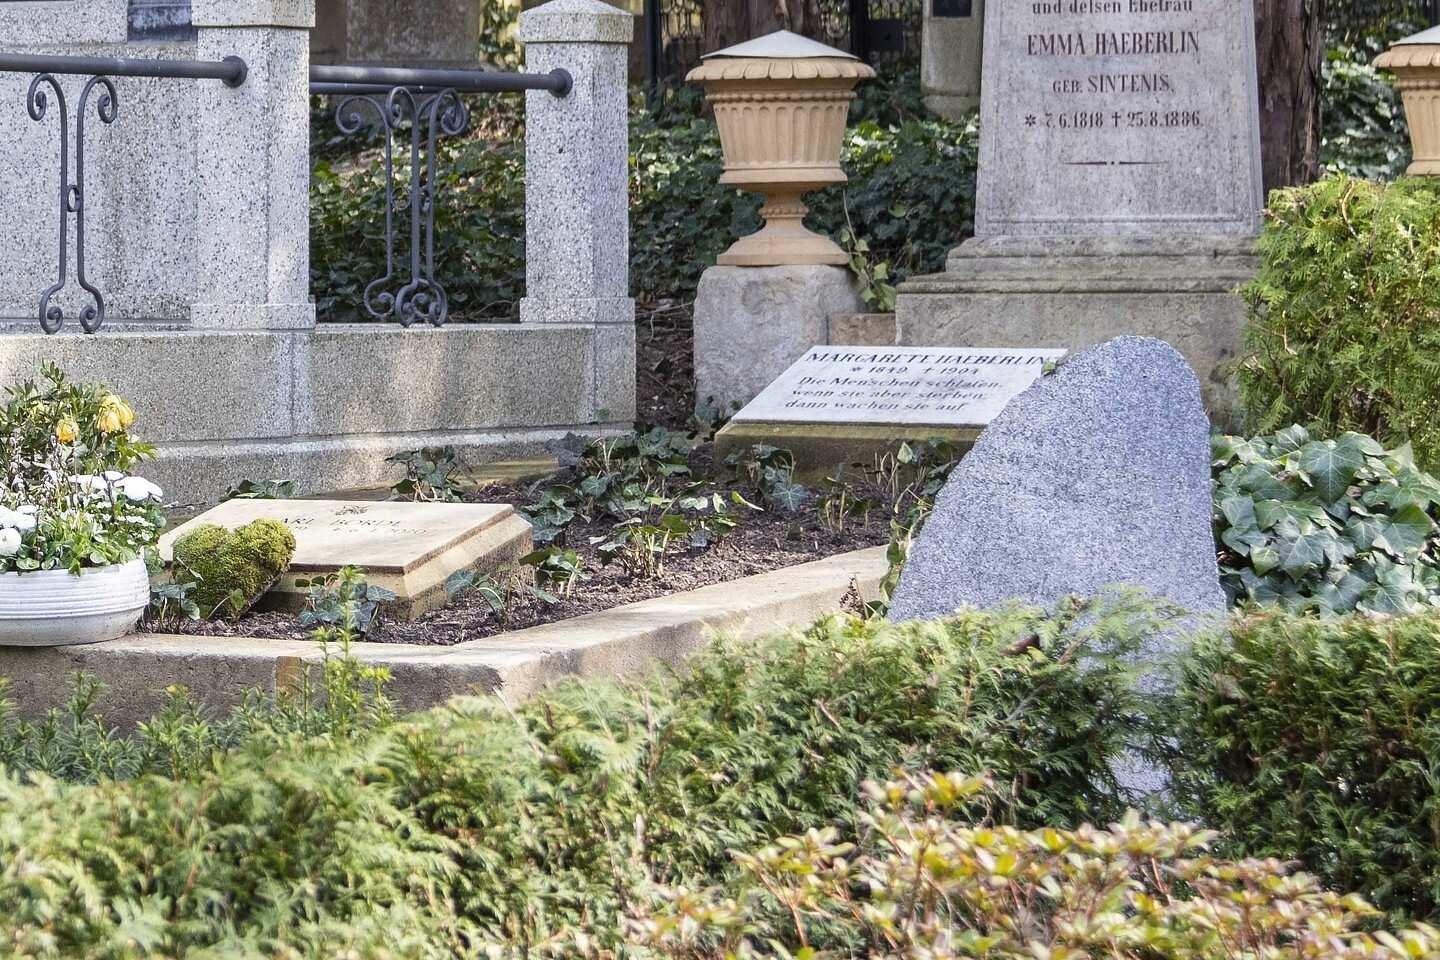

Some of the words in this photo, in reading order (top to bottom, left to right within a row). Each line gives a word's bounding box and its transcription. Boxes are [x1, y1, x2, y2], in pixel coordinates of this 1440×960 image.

[1026, 32, 1086, 56] EMMA
[1094, 30, 1200, 55] HAEBERLIN
[805, 352, 935, 364] MARGARETE
[798, 376, 826, 385] Die
[829, 377, 921, 388] Menschen
[869, 389, 910, 398] aber
[784, 399, 828, 409] dann
[905, 402, 929, 411] sie
